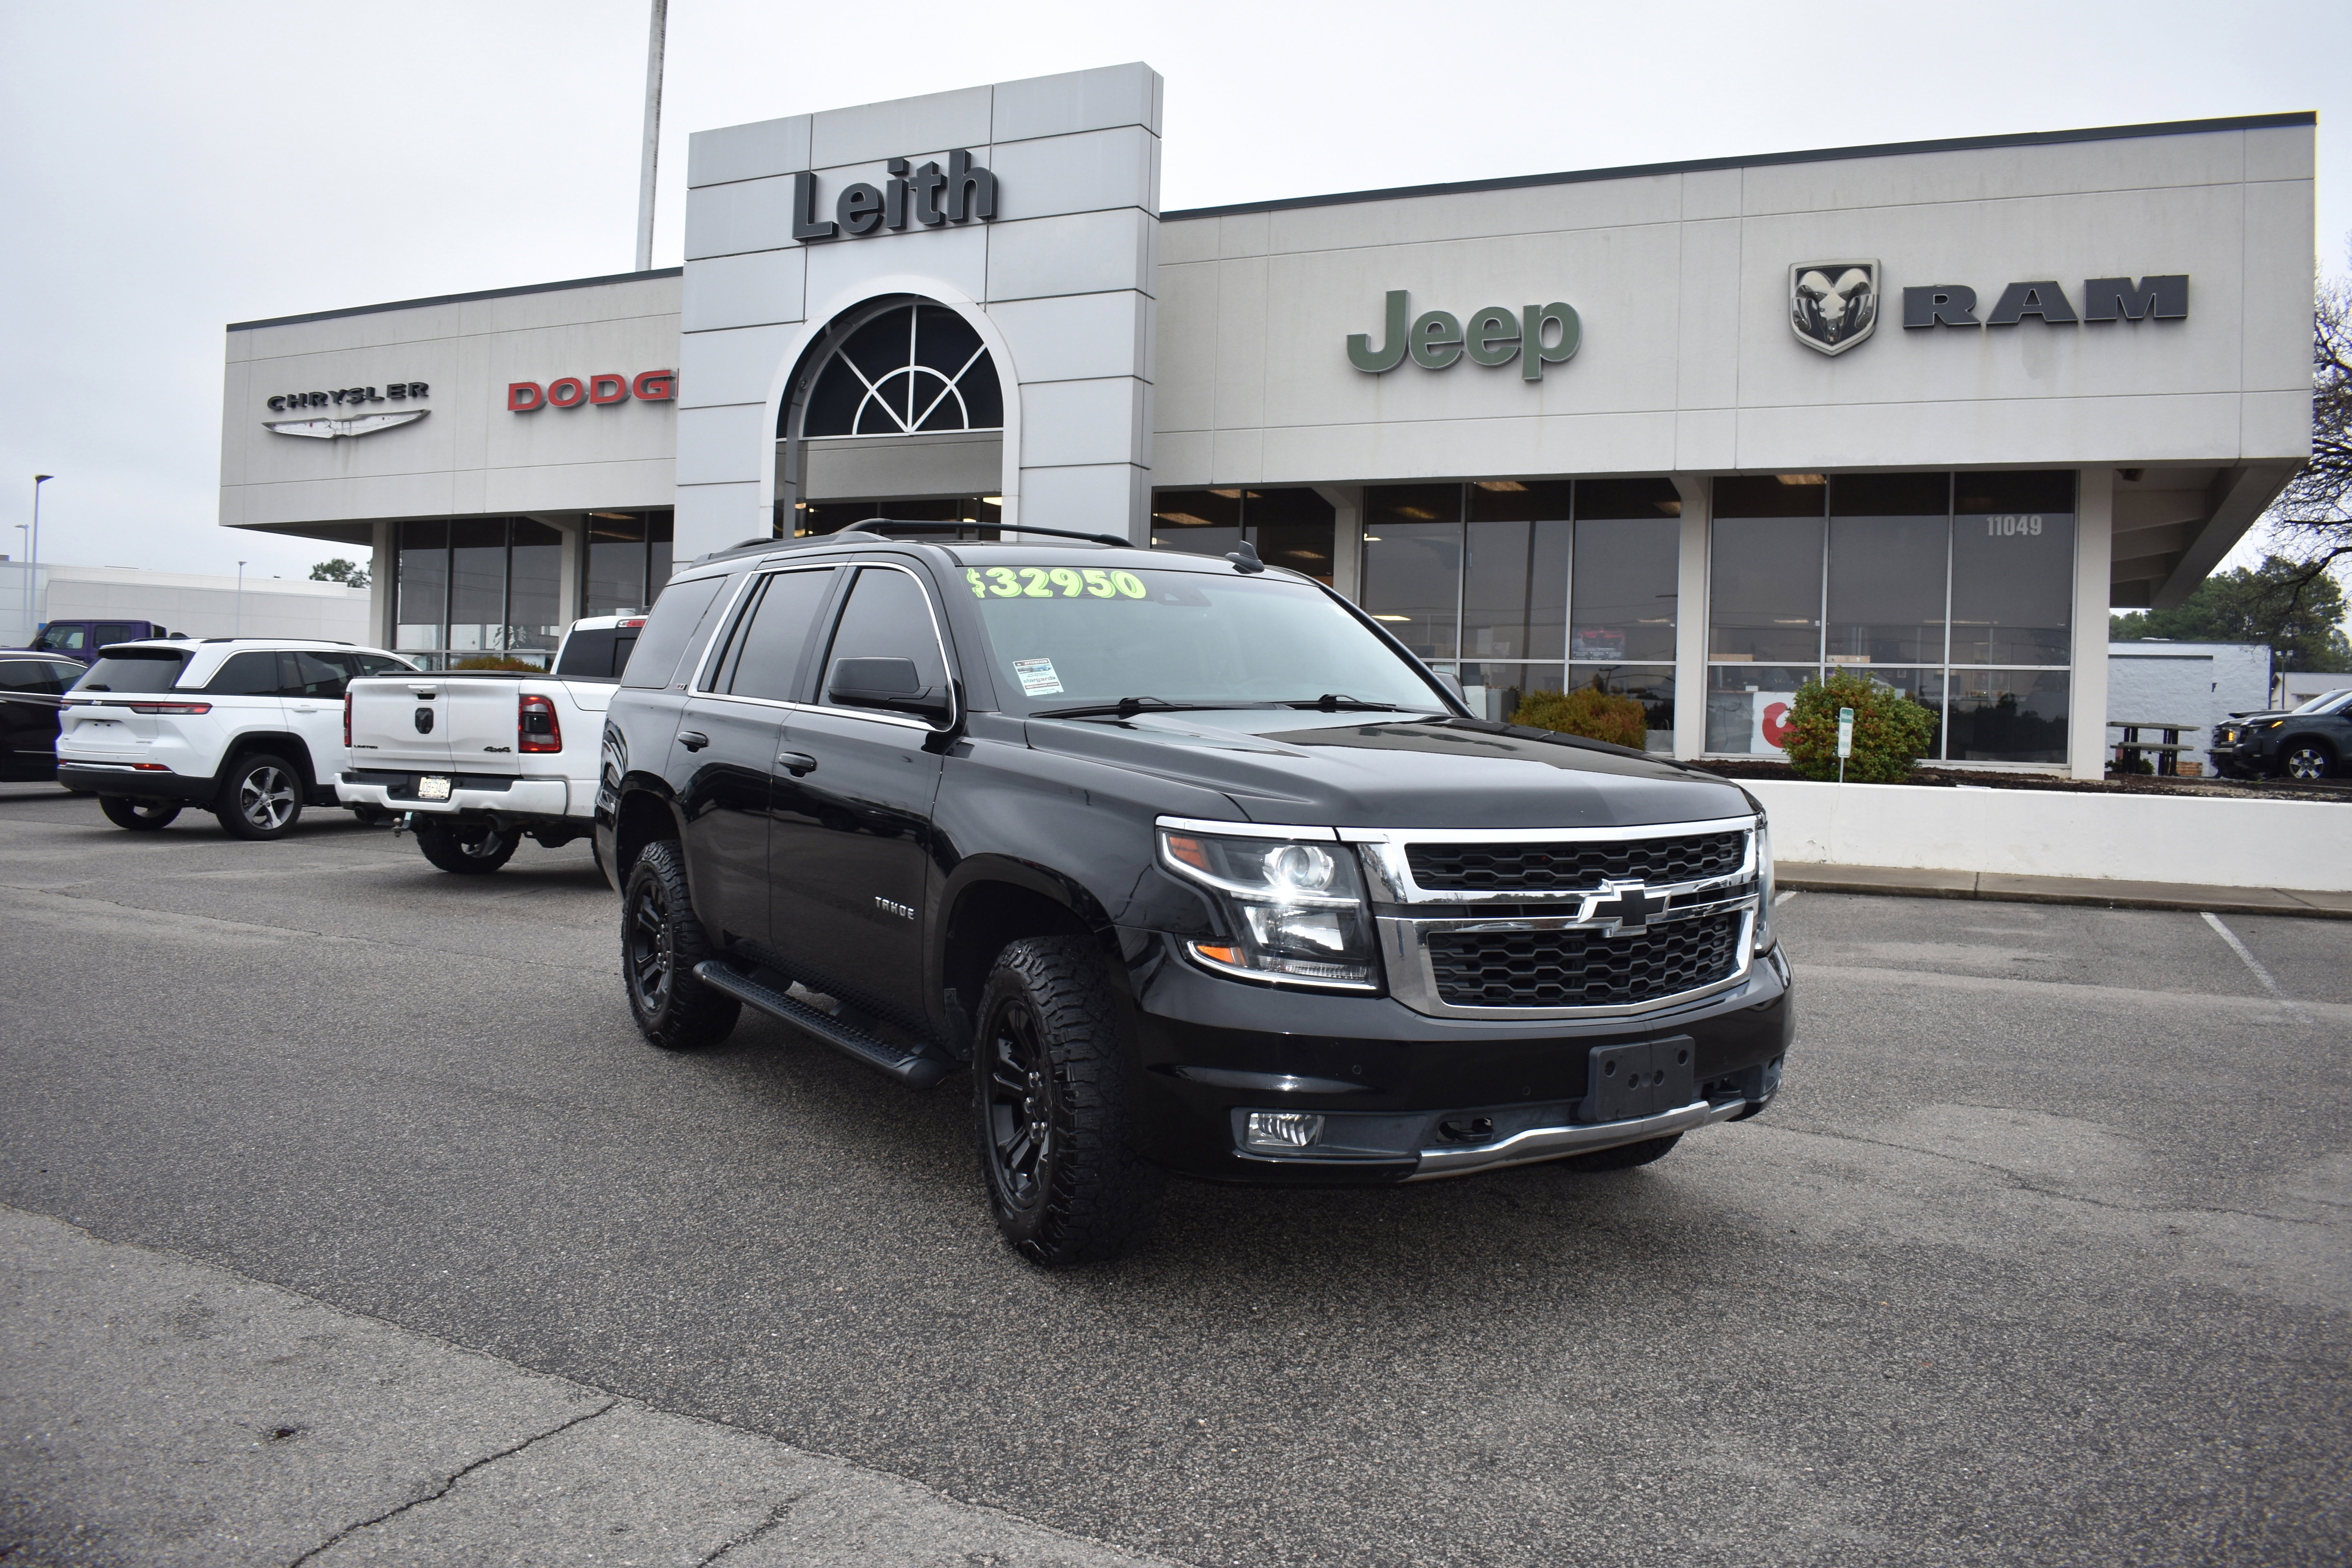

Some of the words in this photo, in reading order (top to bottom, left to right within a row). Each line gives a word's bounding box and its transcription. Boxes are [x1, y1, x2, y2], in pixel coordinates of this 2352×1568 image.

[792, 149, 999, 242] Leith
[1902, 274, 2189, 329] RAM
[1347, 290, 1583, 381] Jeep
[267, 382, 429, 410] CHRYSLER
[508, 368, 679, 412] DODG
[1987, 515, 2042, 536] 11049
[967, 567, 1147, 599] $32950
[875, 896, 915, 920] TAHOE
